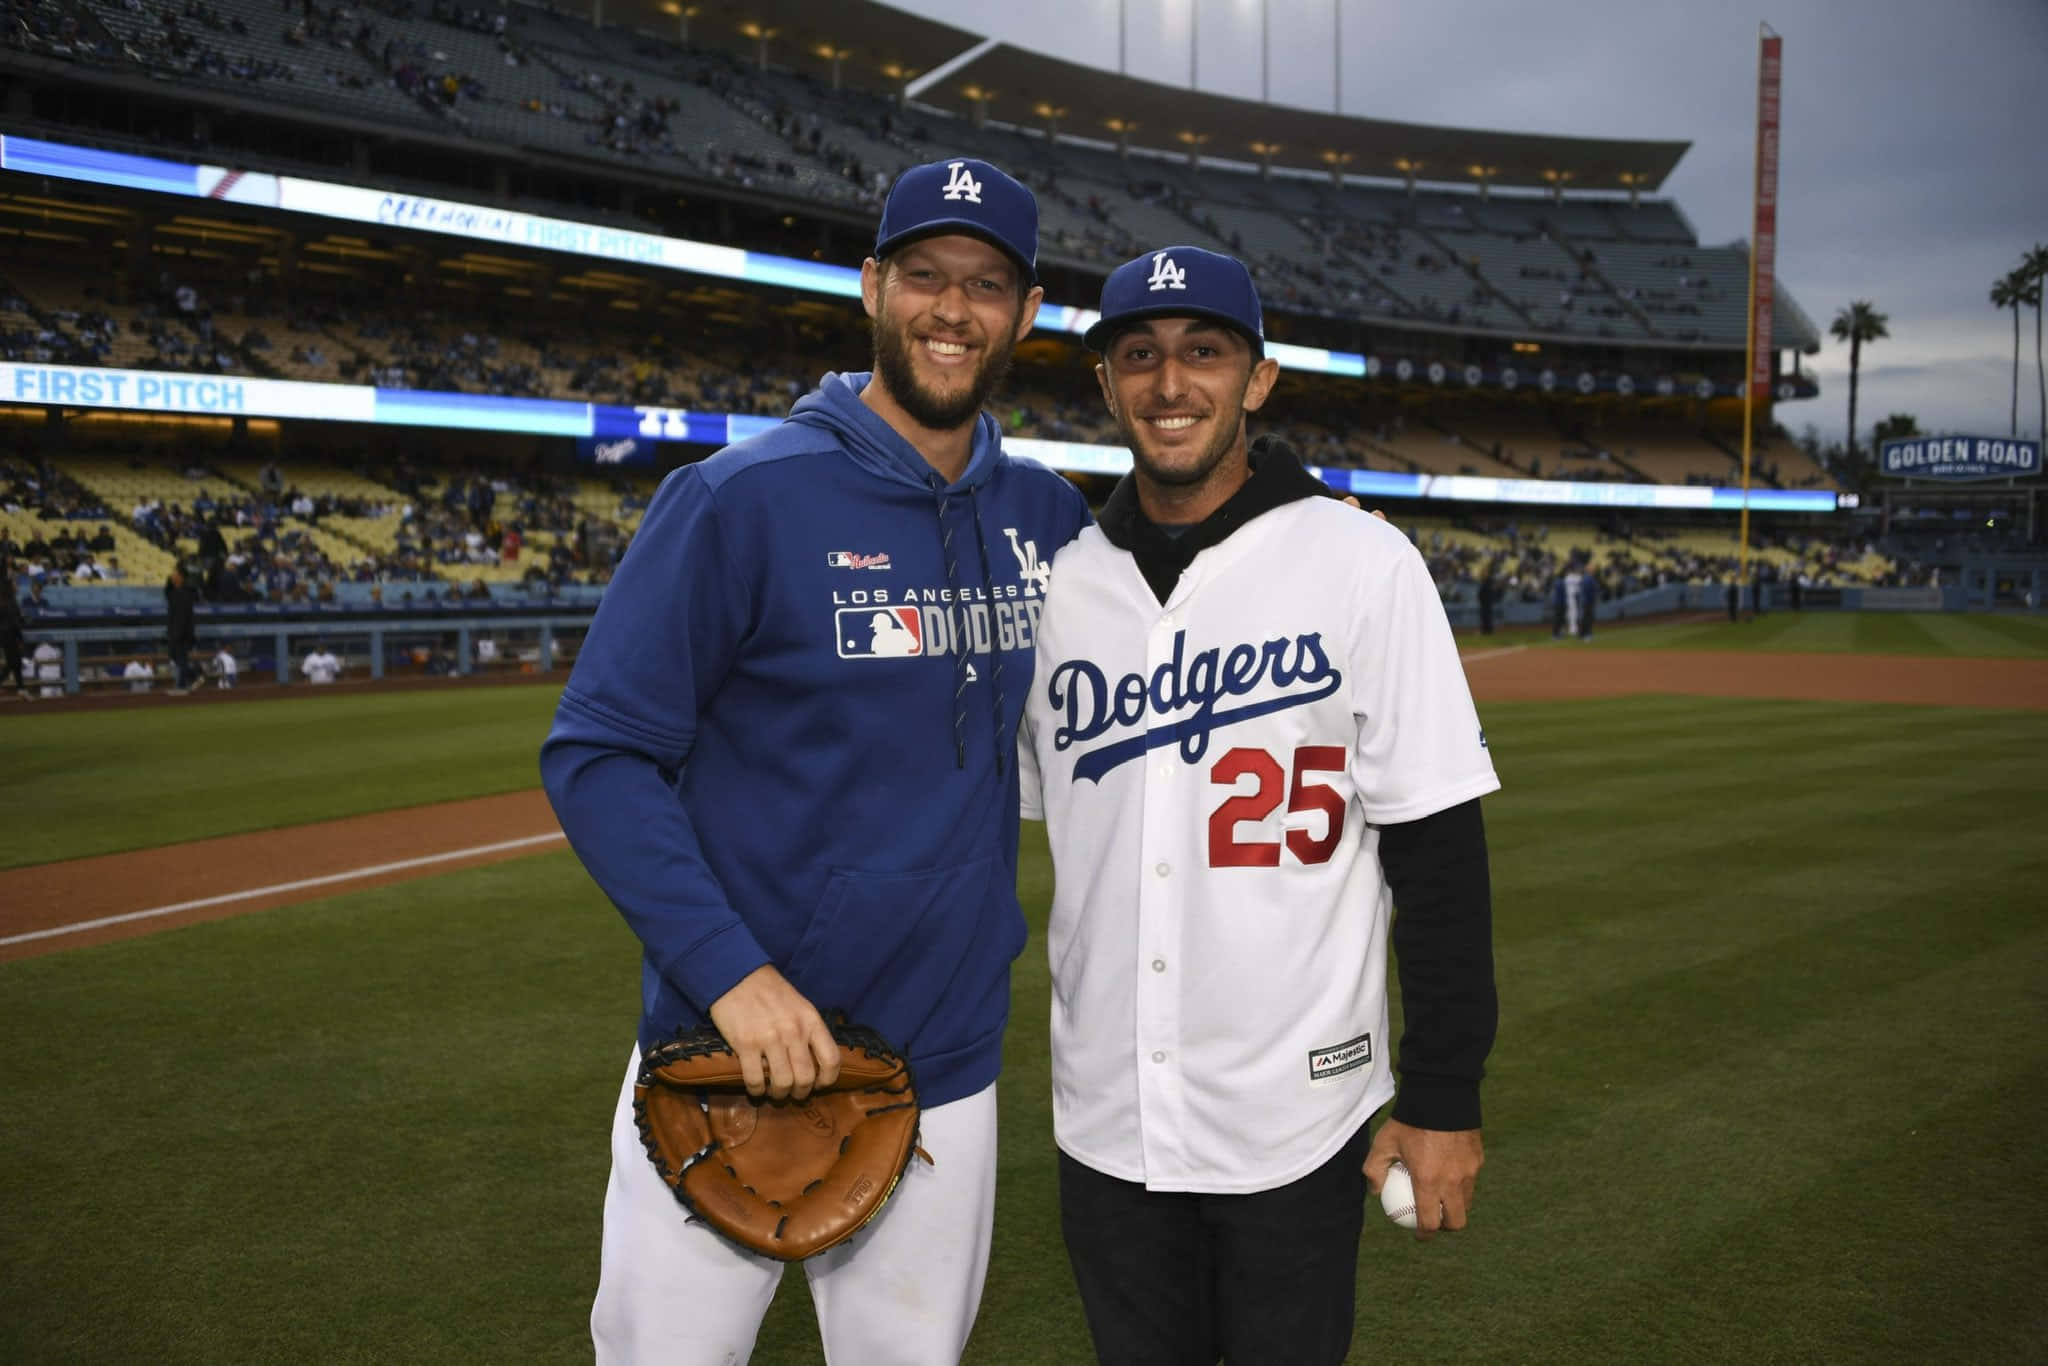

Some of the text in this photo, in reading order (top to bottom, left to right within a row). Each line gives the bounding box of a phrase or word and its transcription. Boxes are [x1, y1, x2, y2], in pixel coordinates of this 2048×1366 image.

[942, 161, 982, 204] LA
[527, 220, 594, 252] FIRST
[599, 231, 664, 262] PITCH
[1147, 252, 1187, 292] LA
[14, 367, 244, 408] FIRST PITCH
[1888, 438, 2033, 470] GOLDEN ROAD
[1003, 528, 1050, 597] LA
[833, 585, 1017, 604] LOS ANGELES
[1048, 629, 1342, 770] Dodgers
[1208, 746, 1346, 868] 25
[1332, 1042, 1367, 1064] Majestic
